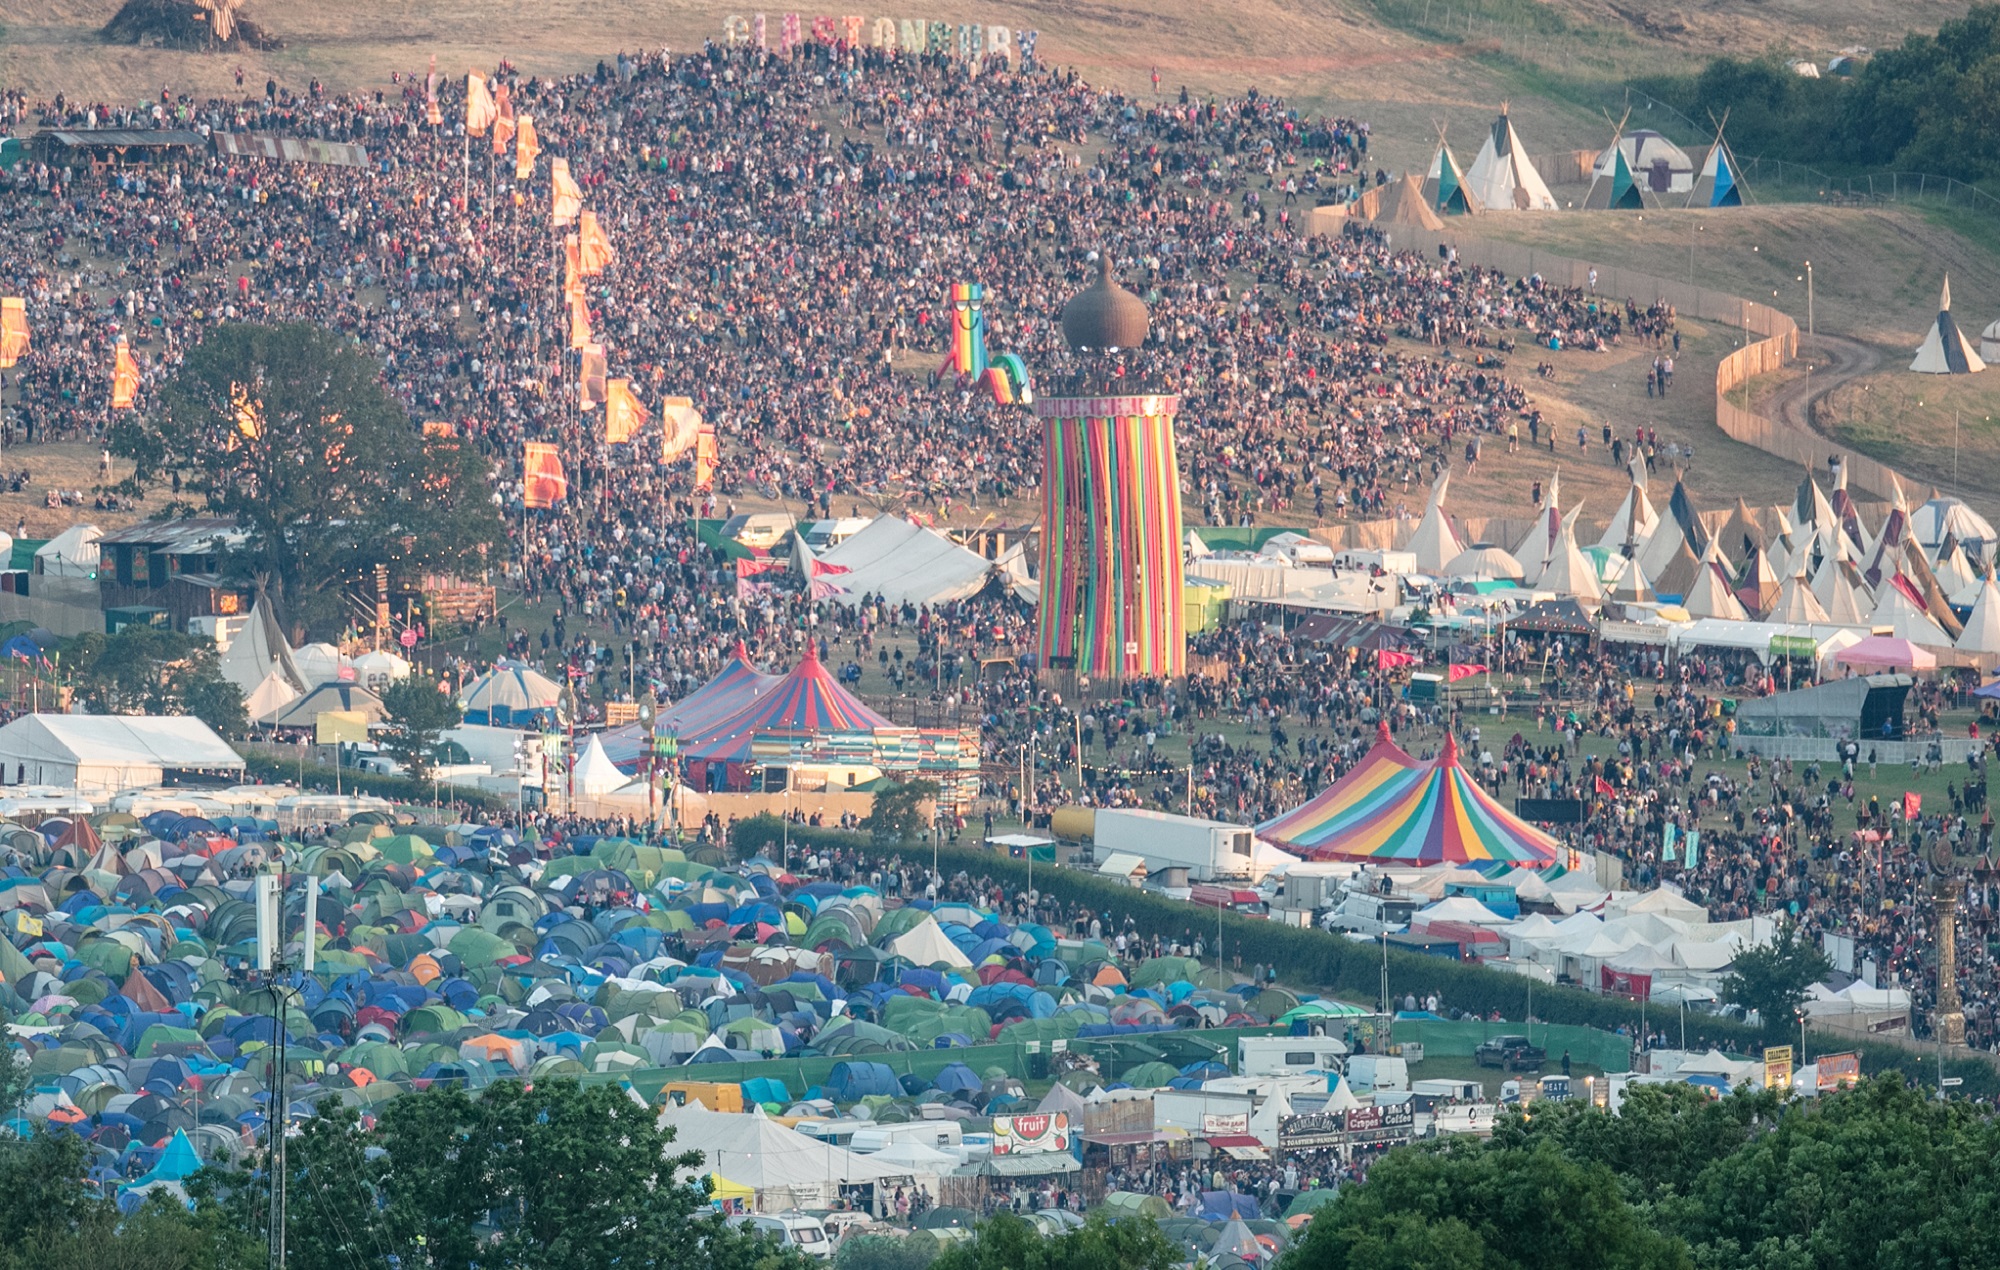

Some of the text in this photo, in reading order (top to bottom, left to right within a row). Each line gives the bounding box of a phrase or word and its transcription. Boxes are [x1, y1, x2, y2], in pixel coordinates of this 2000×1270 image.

[1018, 1116, 1045, 1132] fruit
[1350, 1119, 1378, 1130] Crepes
[1385, 1114, 1412, 1125] Coffee
[1287, 1139, 1314, 1147] TOASTIES
